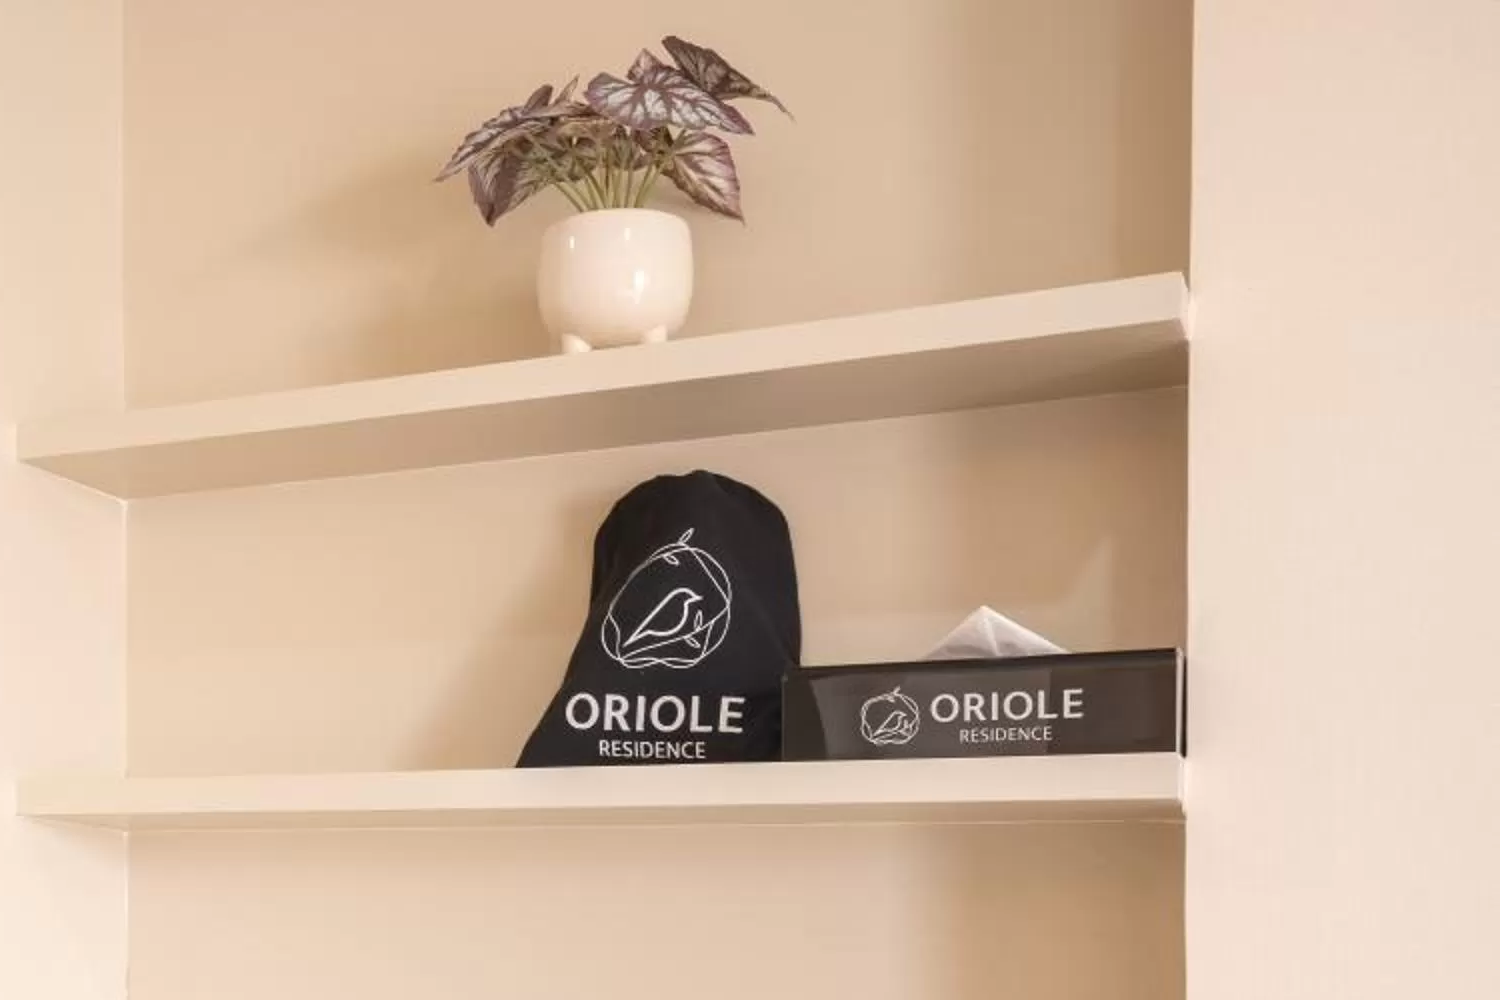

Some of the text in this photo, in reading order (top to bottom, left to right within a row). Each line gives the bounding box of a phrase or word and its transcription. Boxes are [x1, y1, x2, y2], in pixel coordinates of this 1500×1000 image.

[565, 692, 746, 733] ORIOLE
[930, 688, 1084, 723] ORIOLE
[959, 726, 1053, 744] RESIDENCE
[599, 739, 706, 760] RESIDENCE
